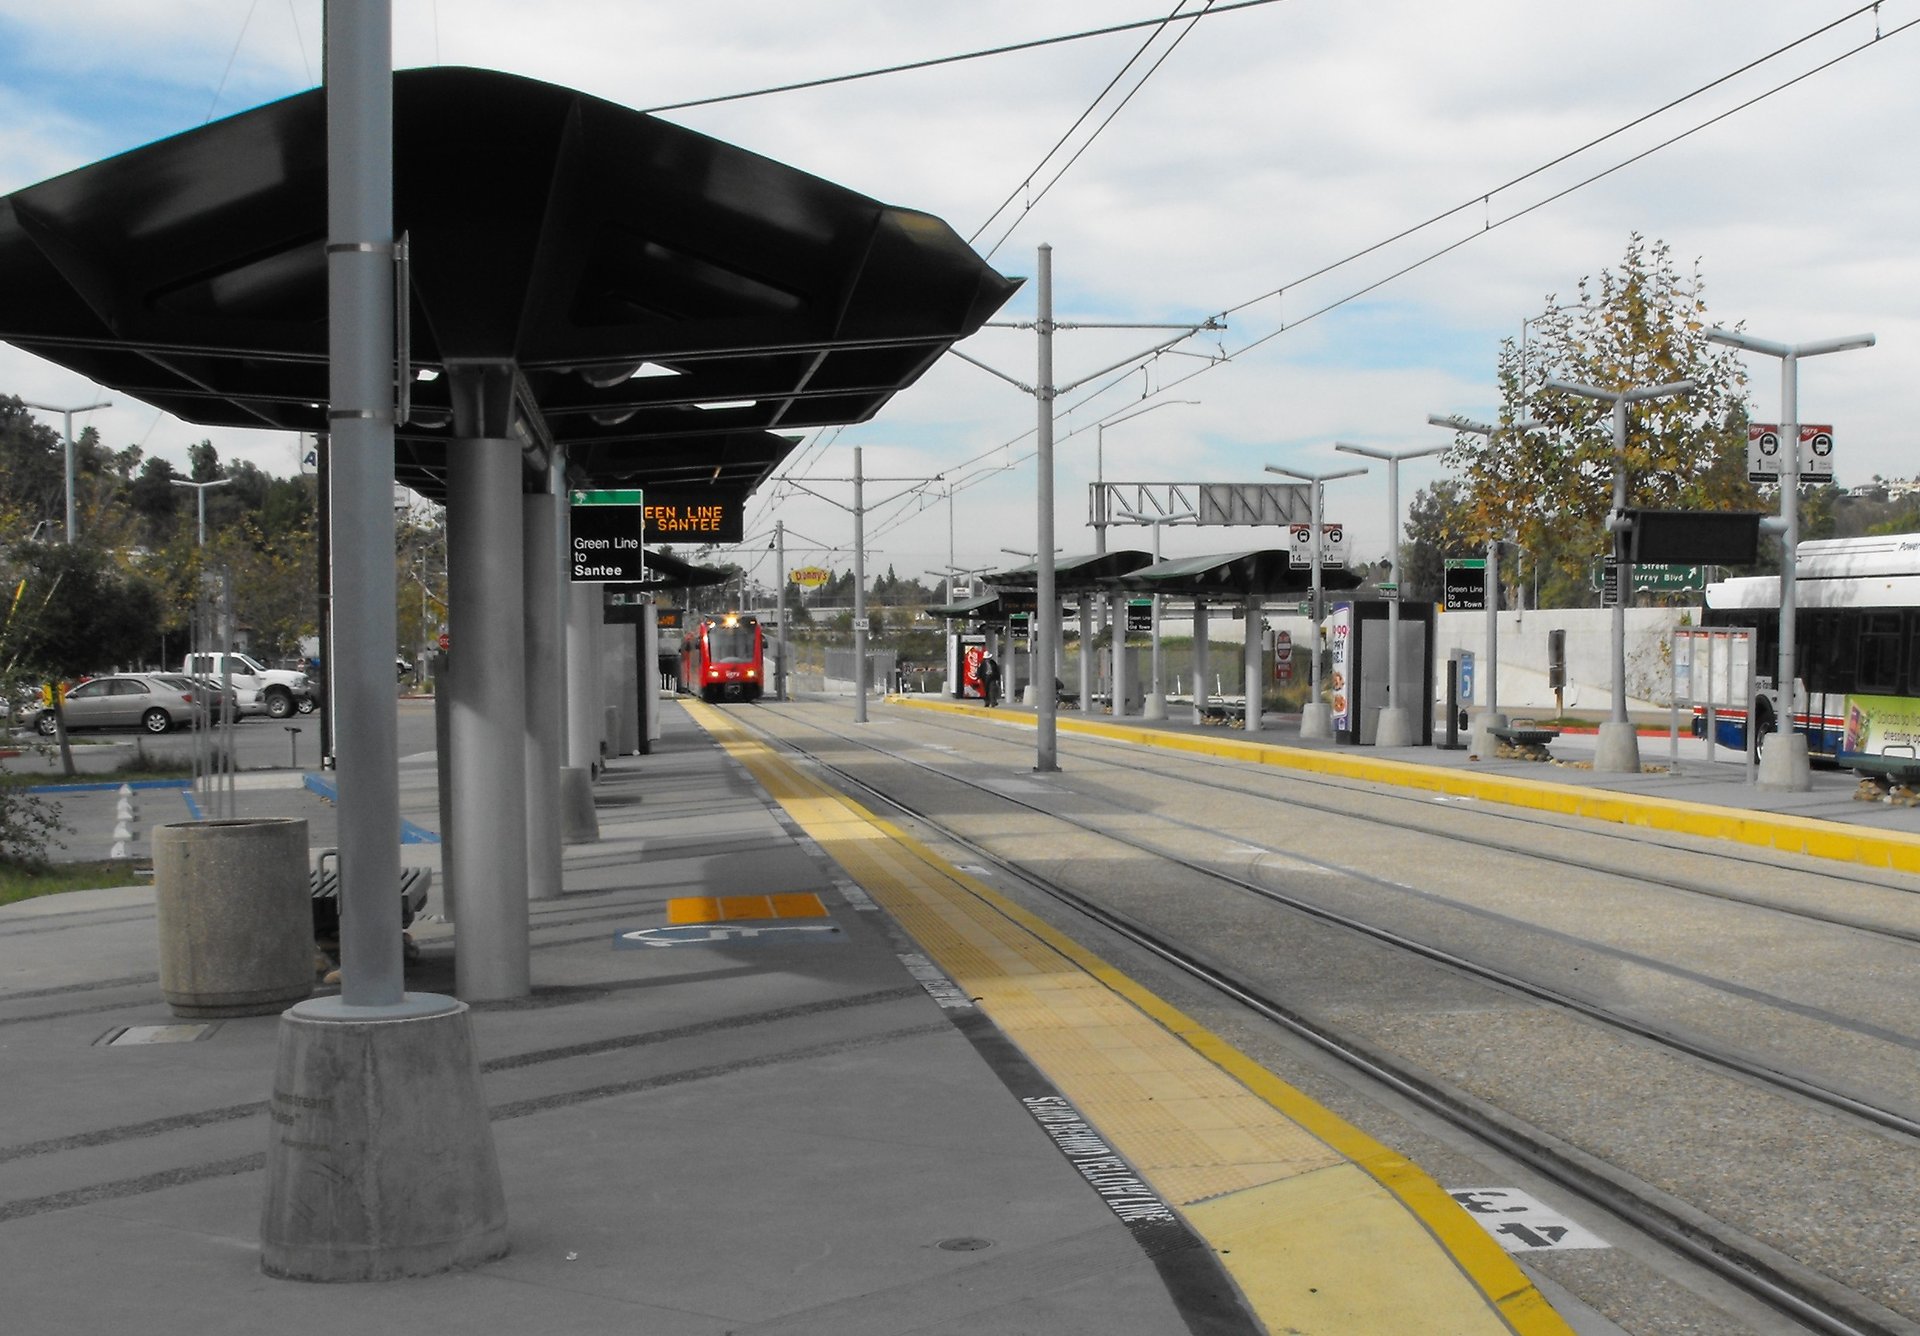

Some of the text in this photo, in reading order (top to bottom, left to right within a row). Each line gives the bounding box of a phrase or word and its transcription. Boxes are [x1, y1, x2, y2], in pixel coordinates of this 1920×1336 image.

[1756, 458, 1762, 471] 1
[1808, 459, 1814, 472] 1
[644, 506, 723, 519] EEN LINE
[657, 518, 721, 531] SANTEE
[574, 537, 638, 549] Green Line
[575, 552, 587, 562] to
[574, 566, 622, 576] Santee
[1632, 574, 1658, 583] urray
[1044, 1123, 1111, 1155] BEHIND
[1073, 1155, 1152, 1195] YELLOW
